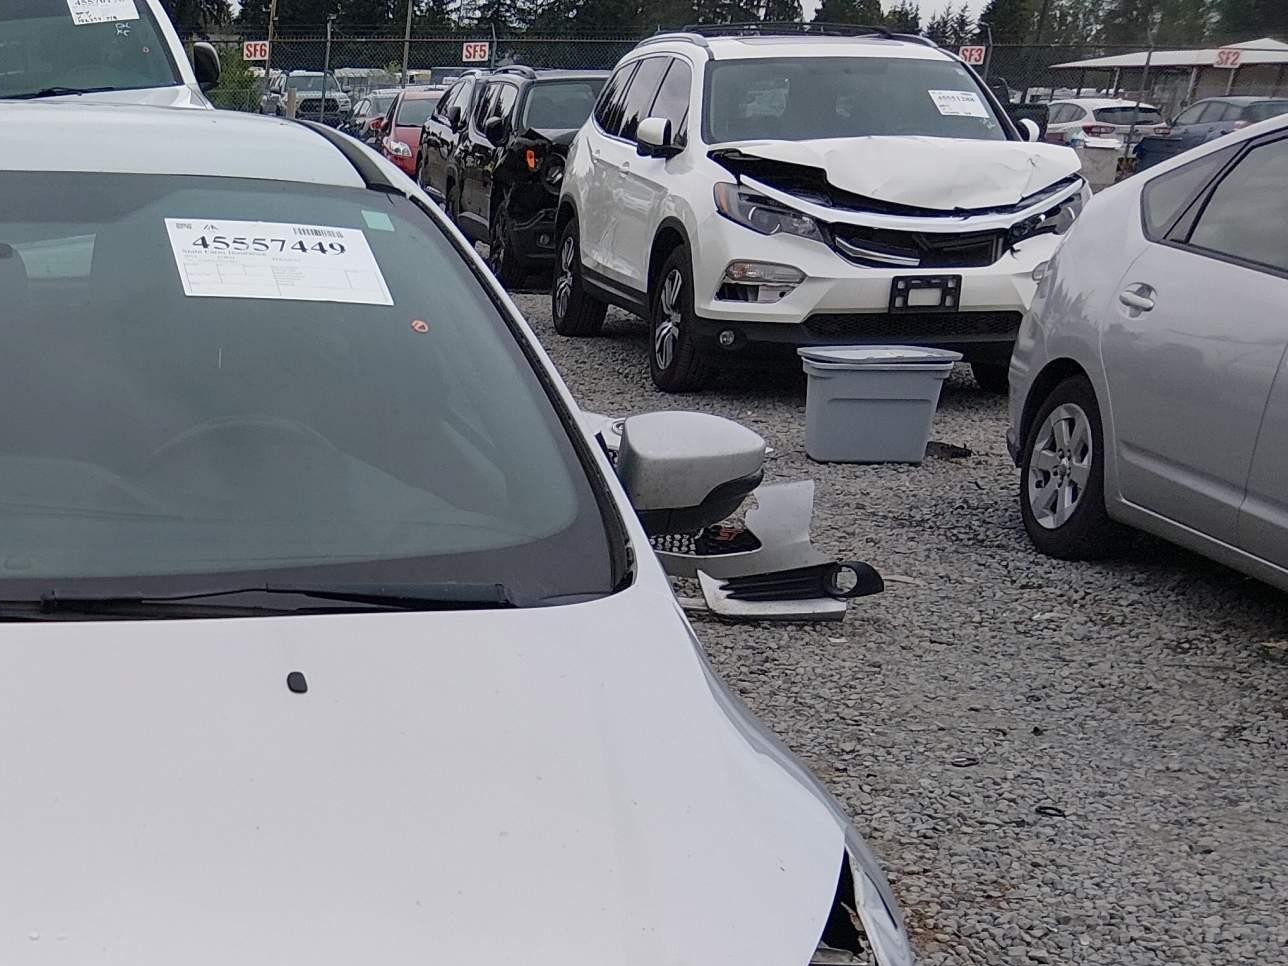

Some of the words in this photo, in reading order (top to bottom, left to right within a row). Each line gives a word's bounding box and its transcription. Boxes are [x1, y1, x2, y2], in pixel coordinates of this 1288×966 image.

[245, 43, 267, 59] SF6
[464, 44, 487, 59] SF5
[961, 48, 983, 62] SF3
[1216, 50, 1241, 66] SF2
[192, 235, 347, 257] 45557449
